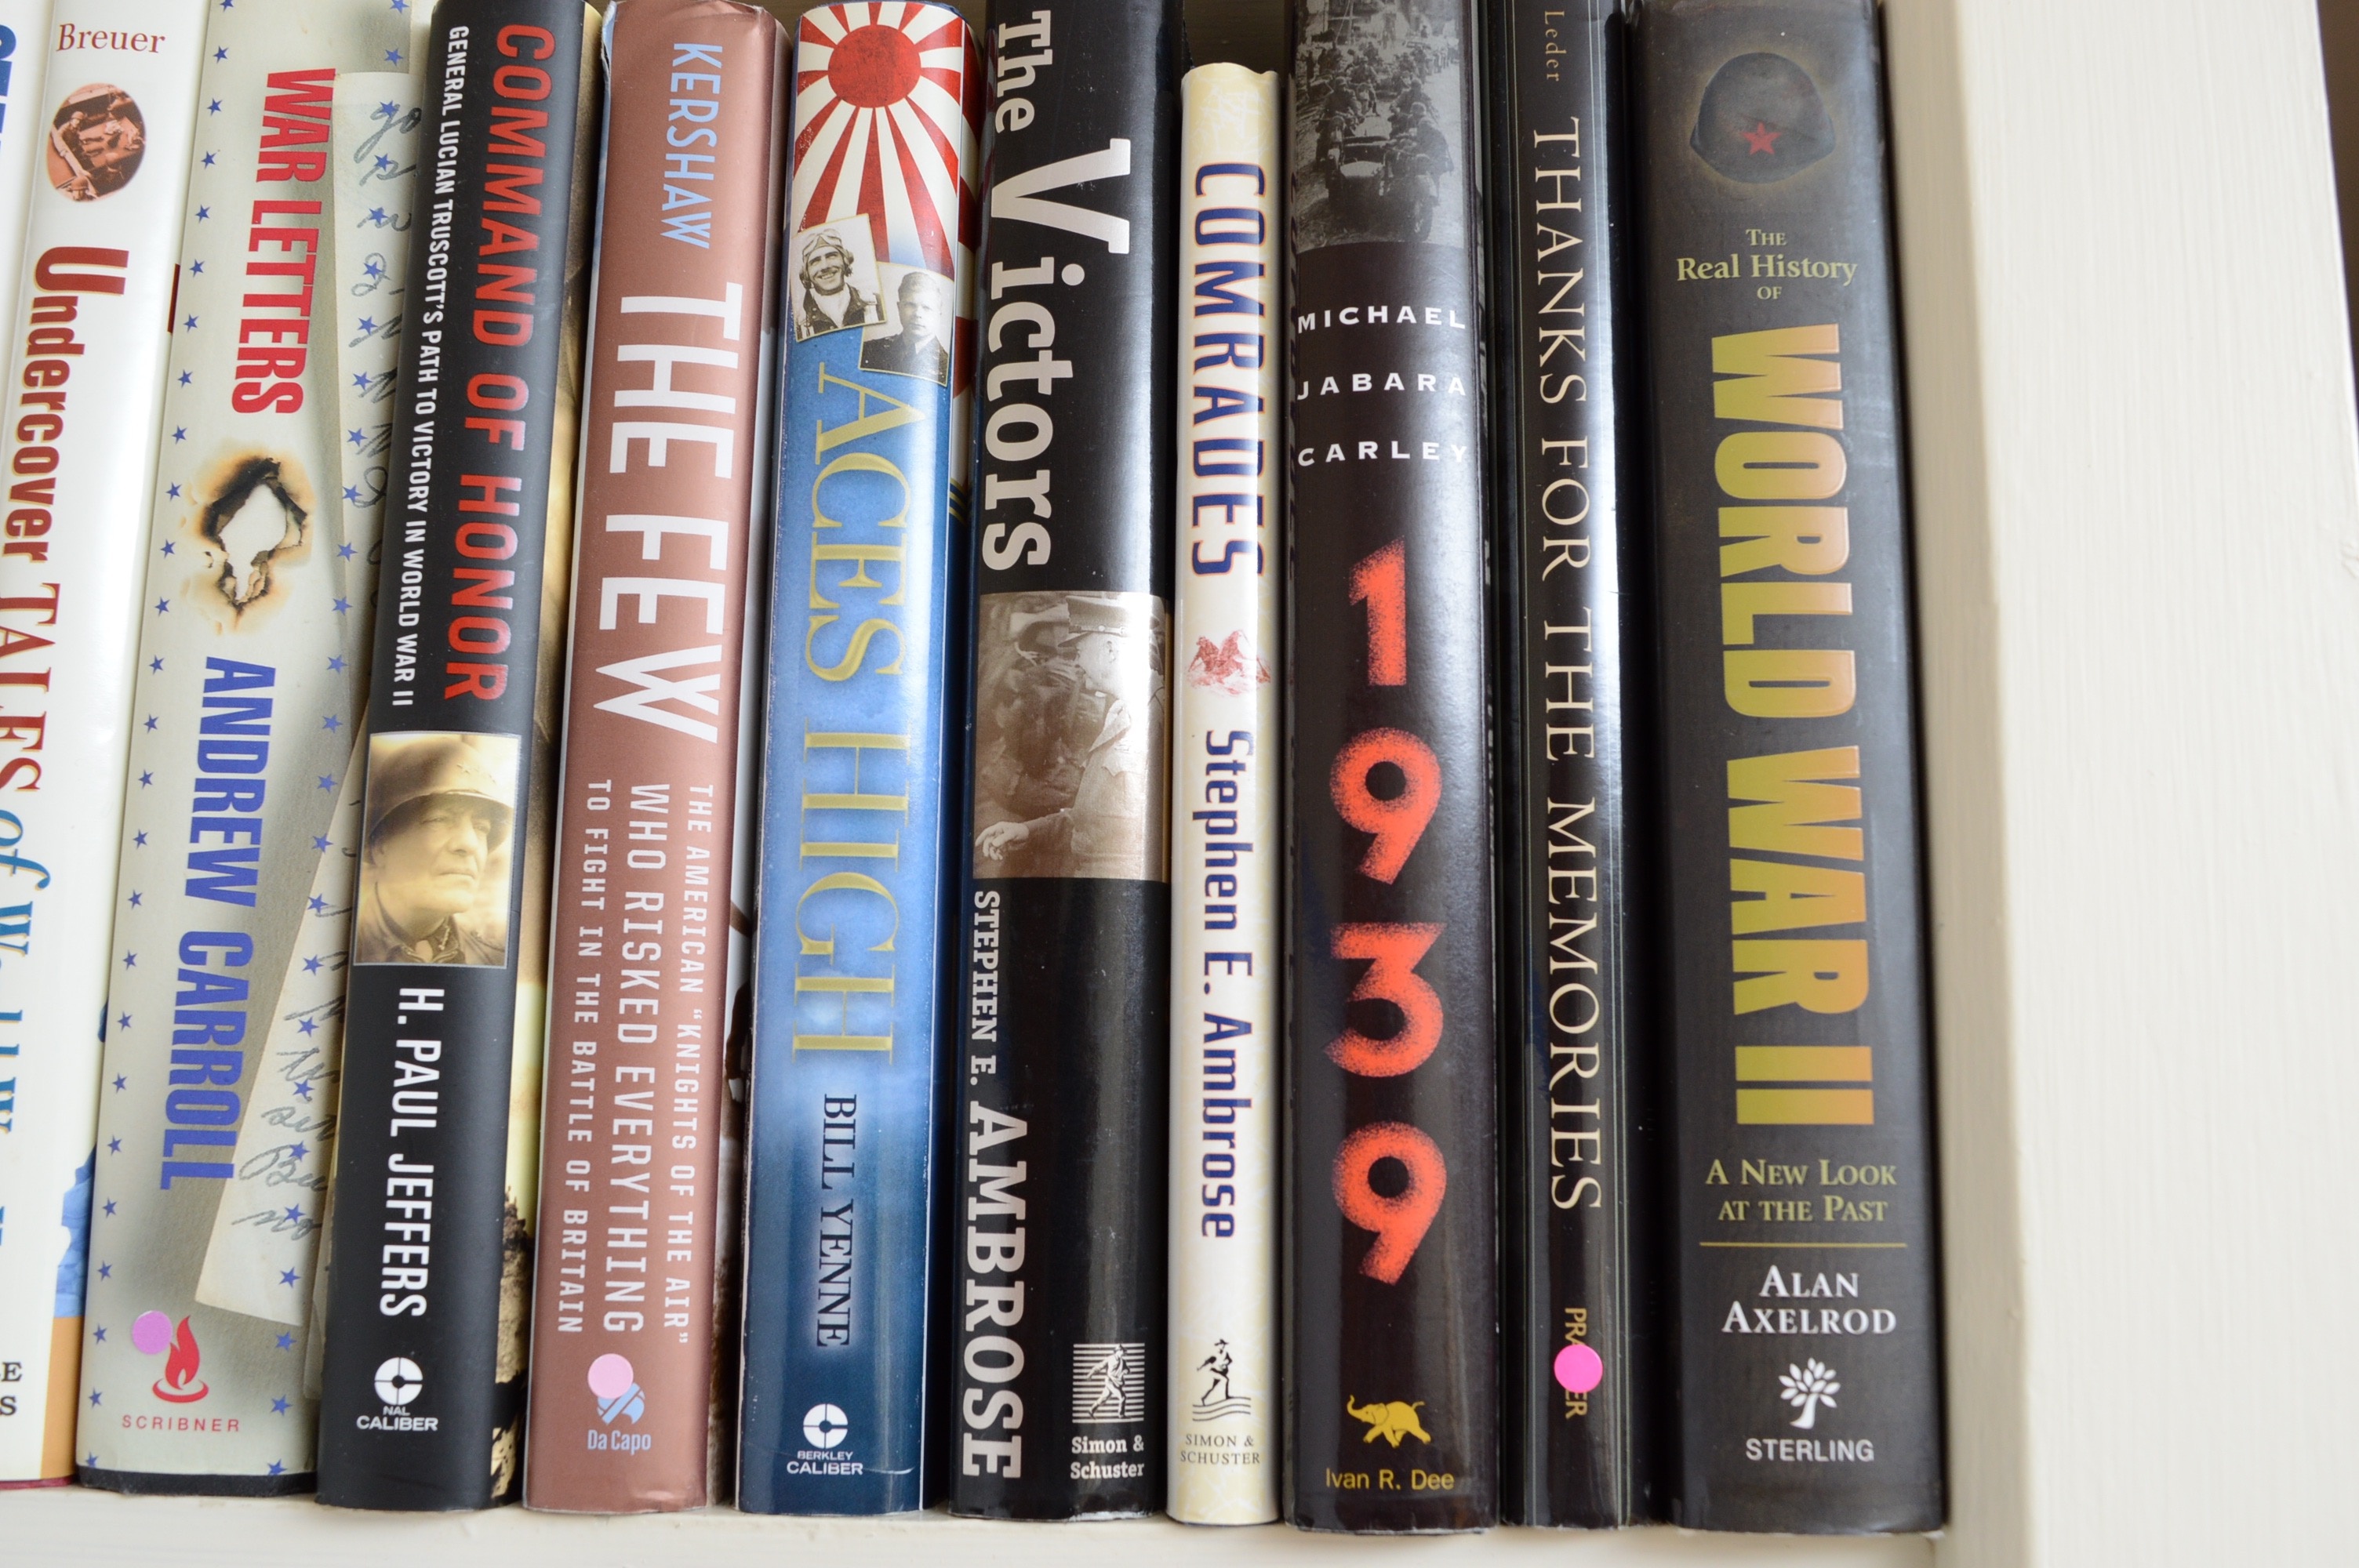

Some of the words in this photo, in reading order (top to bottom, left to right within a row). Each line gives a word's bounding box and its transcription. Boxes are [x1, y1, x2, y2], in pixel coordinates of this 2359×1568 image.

[56, 23, 165, 54] Breuer
[442, 25, 470, 117] GENERAL
[994, 9, 1053, 134] The
[1544, 11, 1567, 82] Leder
[256, 68, 336, 183] WAR
[434, 121, 460, 194] LUCIAN
[660, 42, 723, 249] KERSHAW
[472, 24, 556, 347] COMMAND
[1533, 116, 1587, 405] THANKS
[1677, 253, 1741, 282] Real
[1750, 253, 1858, 286] History
[231, 200, 322, 414] LETTERS
[1297, 305, 1467, 333] MICHAEL
[419, 328, 443, 385] PATH
[609, 281, 743, 479] THE
[982, 137, 1131, 571] Victors
[1190, 162, 1265, 578] COMRADES
[1296, 372, 1467, 401] JABARA
[2, 245, 129, 563] Undercover
[414, 388, 437, 416] TO
[463, 373, 529, 451] OF
[405, 421, 434, 513] VICTORY
[1297, 440, 1469, 467] CARLEY
[405, 521, 426, 543] IN
[805, 361, 927, 681] ACES
[1541, 437, 1591, 583] FOR
[1712, 323, 1856, 718] WORLD
[398, 549, 424, 627] WORLD
[444, 474, 522, 701] HONOR
[593, 514, 729, 743] FEW
[392, 690, 413, 706] II
[394, 633, 419, 682] WAR
[1543, 607, 1595, 761] THE
[184, 656, 276, 908] ANDREW
[586, 779, 612, 811] TO
[687, 784, 714, 832] THE
[626, 782, 671, 869] WHO
[1192, 728, 1254, 931] Stephen
[580, 828, 609, 911] FIGHT
[792, 717, 911, 1065] HIGH
[1324, 536, 1448, 1286] 1939
[1727, 745, 1869, 1015] WAR
[578, 925, 604, 957] IN
[679, 845, 711, 993] AMERICAN
[398, 987, 445, 1024] H.
[574, 972, 601, 1022] THE
[617, 890, 666, 1044] RISKED
[971, 890, 1000, 1042] STEPHEN
[1202, 951, 1253, 996] E.
[1547, 795, 1602, 1209] MEMORIES
[160, 930, 254, 1191] CARROLL
[390, 1039, 442, 1138] PAUL
[567, 1041, 598, 1143] BATTLE
[969, 1054, 997, 1086] E.
[1736, 1046, 1874, 1124] II
[821, 1093, 858, 1190] BILL
[1201, 1011, 1253, 1239] Ambrose
[564, 1160, 591, 1193] OF
[603, 1067, 656, 1334] EVERYTHING
[669, 1164, 696, 1198] OF
[1706, 1159, 1729, 1185] A
[380, 1152, 434, 1317] JEFFERS
[558, 1210, 589, 1334] BRITAIN
[666, 1211, 694, 1263] THE
[816, 1198, 855, 1348] YENNE
[961, 1100, 1028, 1479] AMBROSE
[121, 1414, 240, 1432] SCRIBNER
[356, 1415, 438, 1431] CALIBER
[382, 1406, 410, 1417] NAL
[587, 1429, 607, 1450] Da
[611, 1431, 652, 1456] Capo
[1072, 1437, 1128, 1454] Simon
[1132, 1435, 1144, 1453] &
[1185, 1433, 1237, 1448] SIMON
[1244, 1434, 1255, 1447] &
[1745, 1438, 1875, 1462] STERLING
[787, 1461, 863, 1475] CALIBER
[798, 1450, 853, 1461] BERKLEY
[1070, 1461, 1145, 1479] Schuster
[1180, 1450, 1261, 1465] SCHUSTER
[1325, 1467, 1369, 1489] Ivan
[1378, 1469, 1401, 1490] R.
[1412, 1468, 1455, 1490] Dee
